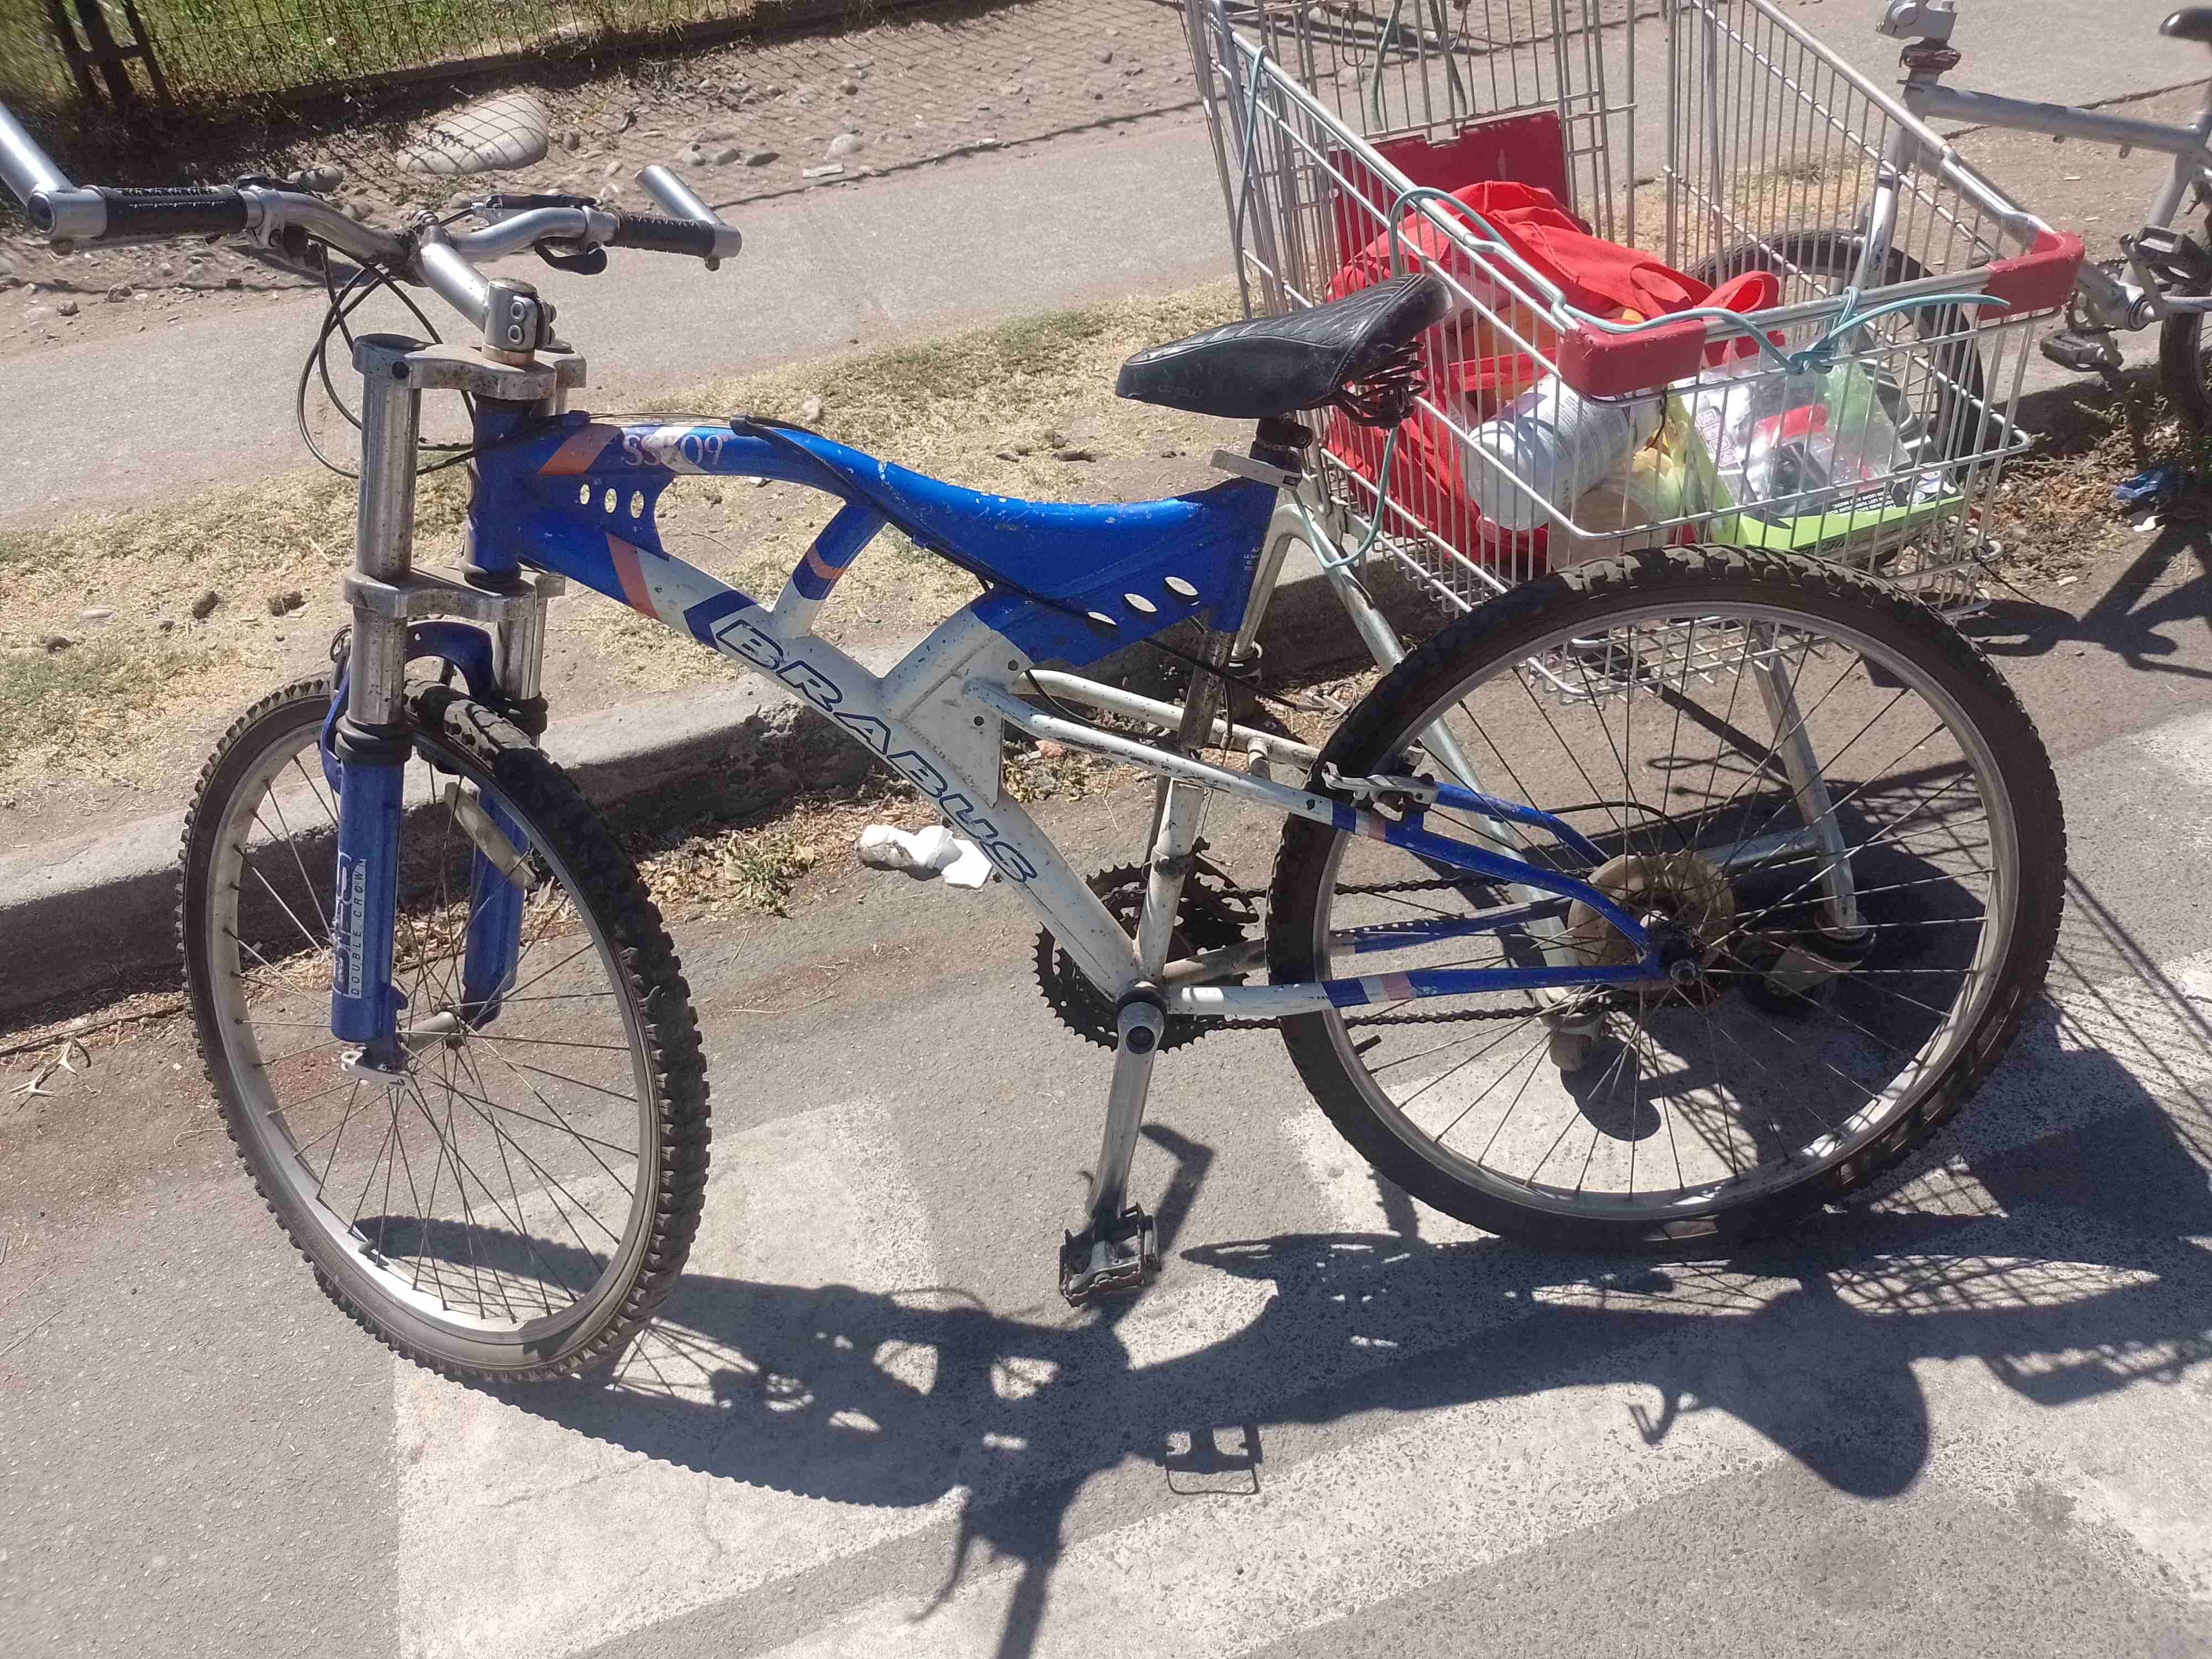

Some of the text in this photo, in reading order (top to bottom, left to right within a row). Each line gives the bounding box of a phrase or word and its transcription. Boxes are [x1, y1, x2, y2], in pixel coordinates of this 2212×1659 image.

[716, 618, 1038, 884] BRABUS
[351, 858, 366, 996] DOUBLE CROWN
